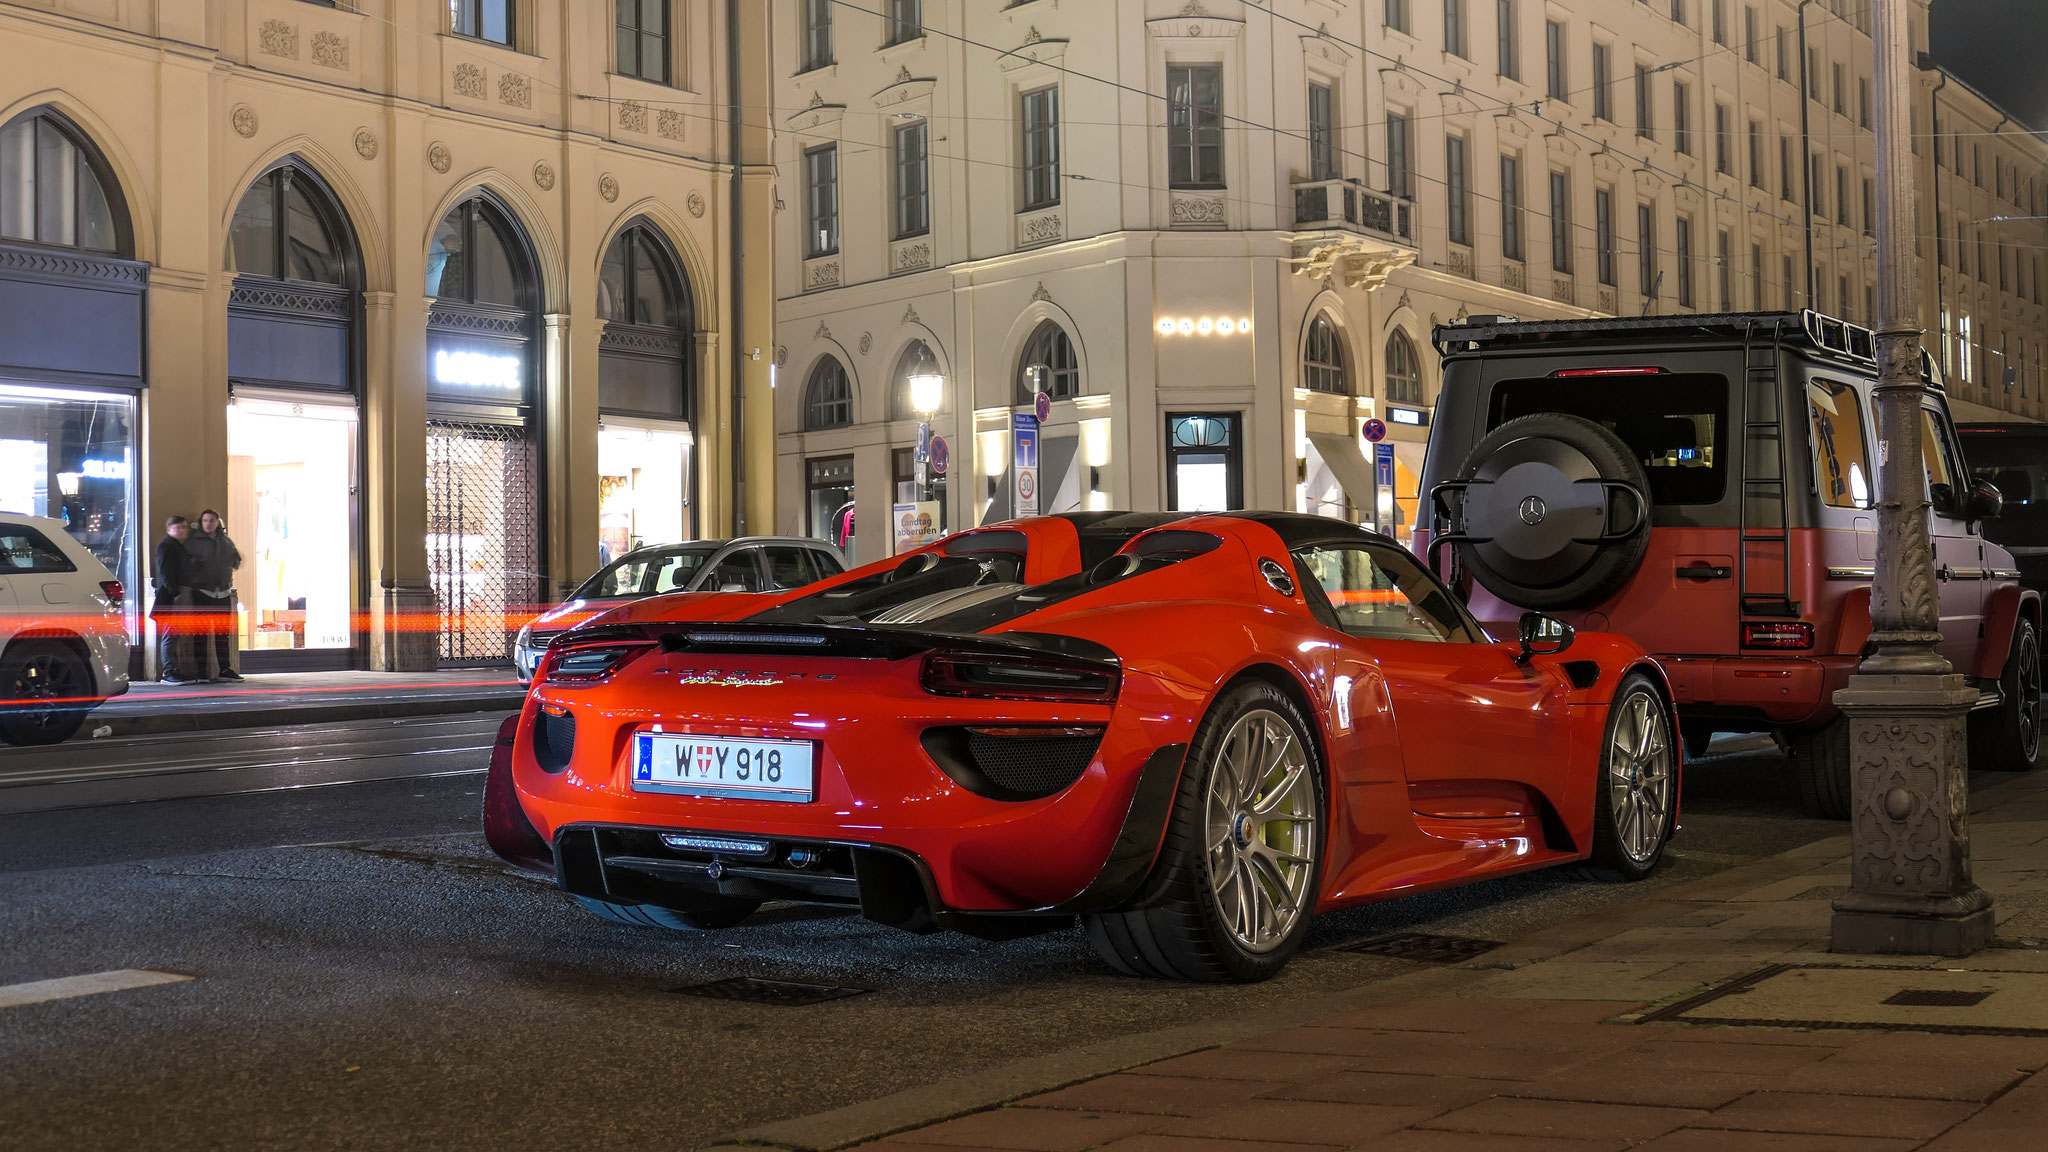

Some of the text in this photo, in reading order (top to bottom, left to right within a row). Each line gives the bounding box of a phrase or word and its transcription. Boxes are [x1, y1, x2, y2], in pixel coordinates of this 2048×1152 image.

[1160, 320, 1248, 332] MARNI
[1021, 478, 1031, 491] 30
[901, 518, 932, 528] Landtag
[897, 526, 937, 536] abberufen
[641, 763, 649, 774] A
[675, 744, 782, 783] W Y 918
